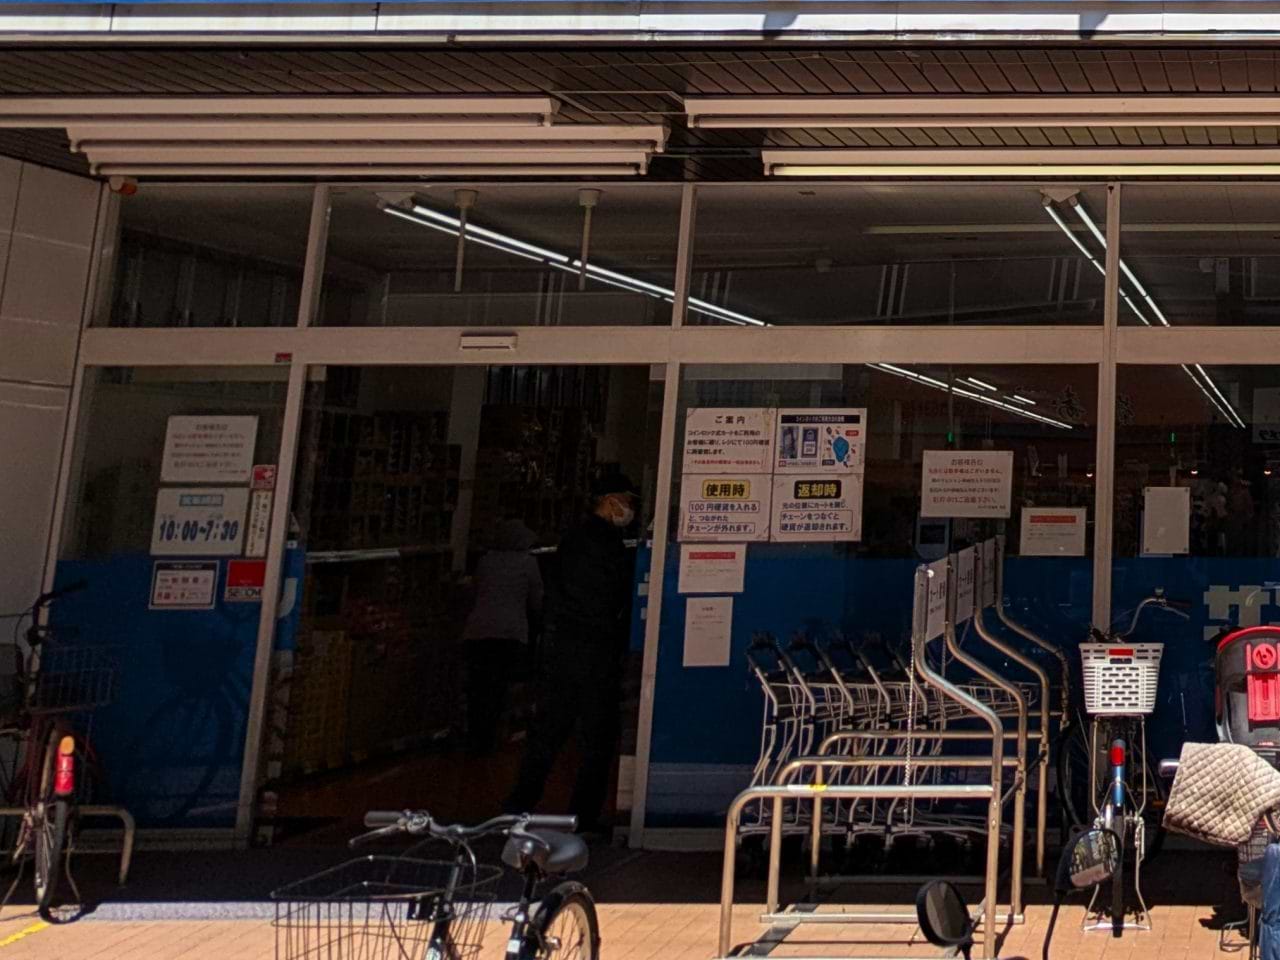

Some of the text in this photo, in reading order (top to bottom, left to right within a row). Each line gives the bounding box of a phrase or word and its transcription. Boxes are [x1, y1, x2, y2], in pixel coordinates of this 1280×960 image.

[714, 415, 745, 424] ご案内
[706, 482, 745, 497] 使用時
[797, 483, 837, 497] 返却時
